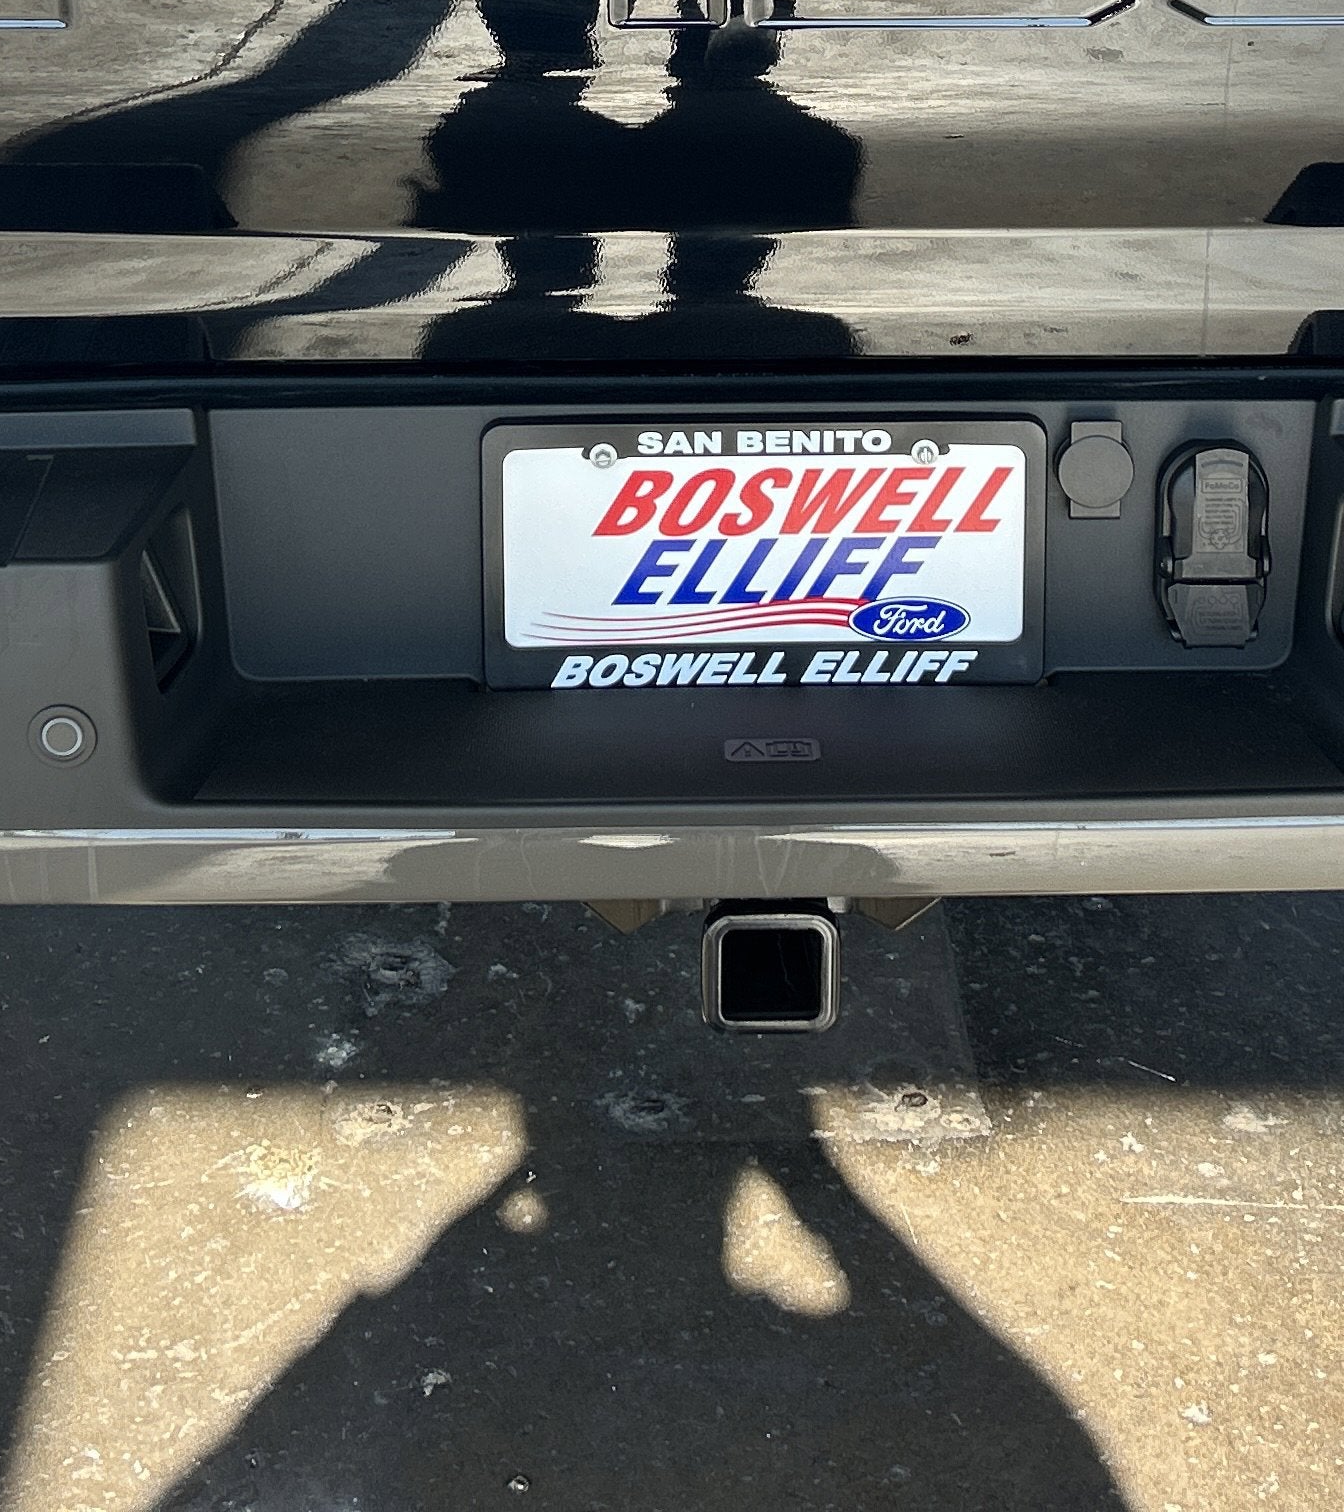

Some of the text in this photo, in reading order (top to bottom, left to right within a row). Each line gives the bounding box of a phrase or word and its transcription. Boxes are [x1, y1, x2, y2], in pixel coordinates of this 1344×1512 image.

[637, 430, 892, 455] SAN BENITO
[592, 467, 1014, 537] BOSWELL
[612, 536, 942, 605] ELLIFF
[873, 604, 946, 635] Ford
[551, 650, 978, 688] BOSWELL ELLIFF
